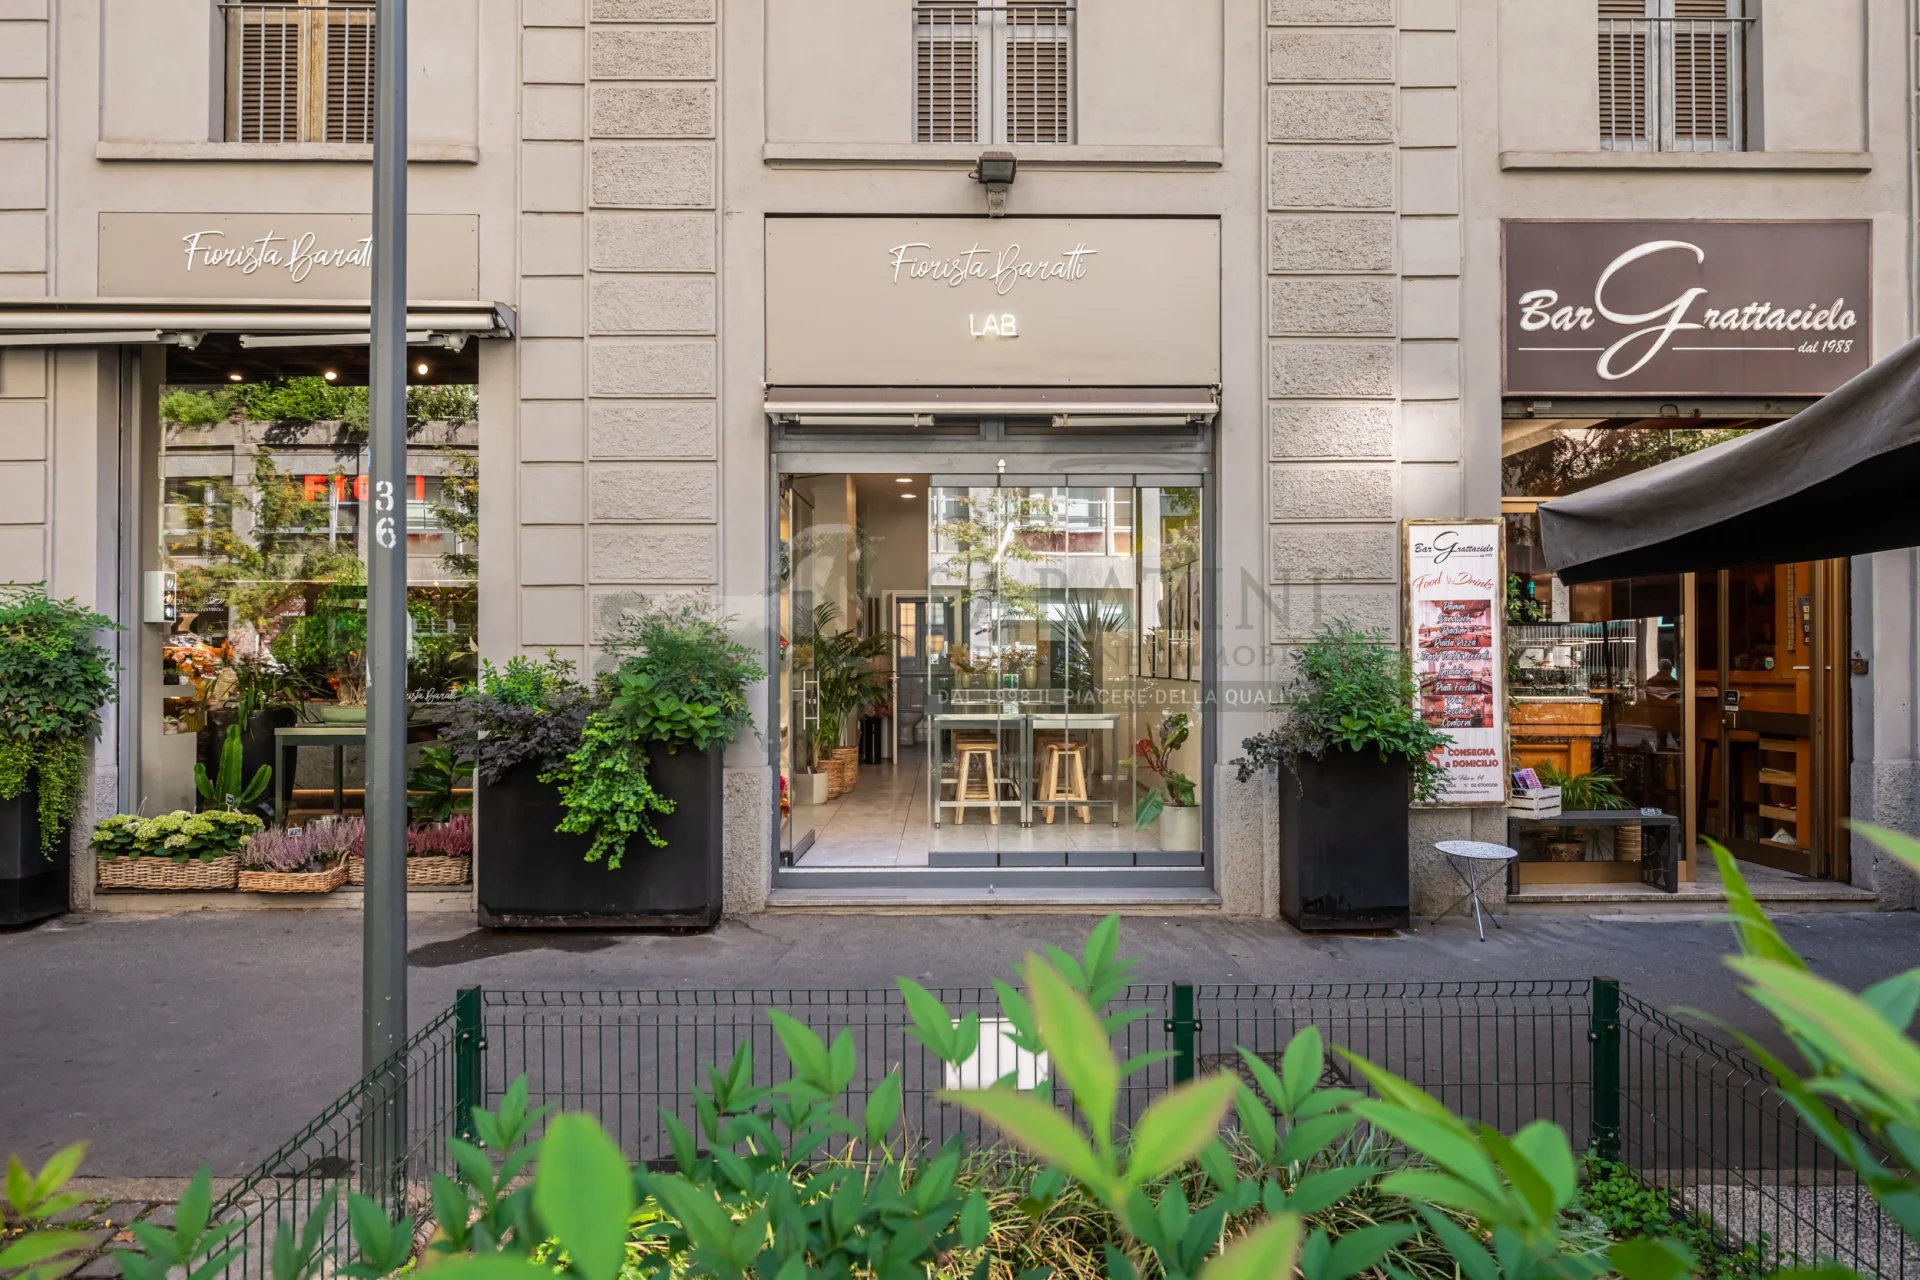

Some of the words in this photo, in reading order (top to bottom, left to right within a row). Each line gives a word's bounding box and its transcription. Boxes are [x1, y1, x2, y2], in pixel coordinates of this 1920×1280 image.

[182, 229, 283, 274] Fiorista
[283, 230, 373, 283] Baratt
[888, 242, 991, 287] Fiorista
[989, 242, 1098, 295] Baratti
[1518, 289, 1595, 332] Bar
[1594, 240, 1857, 380] Grattacielo
[969, 313, 1018, 337] LAB
[1798, 341, 1819, 354] dal
[1822, 340, 1854, 354] 1988
[1414, 543, 1432, 553] Bar
[1433, 531, 1494, 564] Grattacielo
[1413, 571, 1443, 592] Food
[1452, 572, 1494, 590] Drinks
[1456, 637, 1477, 647] Pizza
[1441, 718, 1472, 727] Contorni
[1447, 748, 1496, 757] CONSEGNA
[1452, 759, 1499, 768] DOMICILIO
